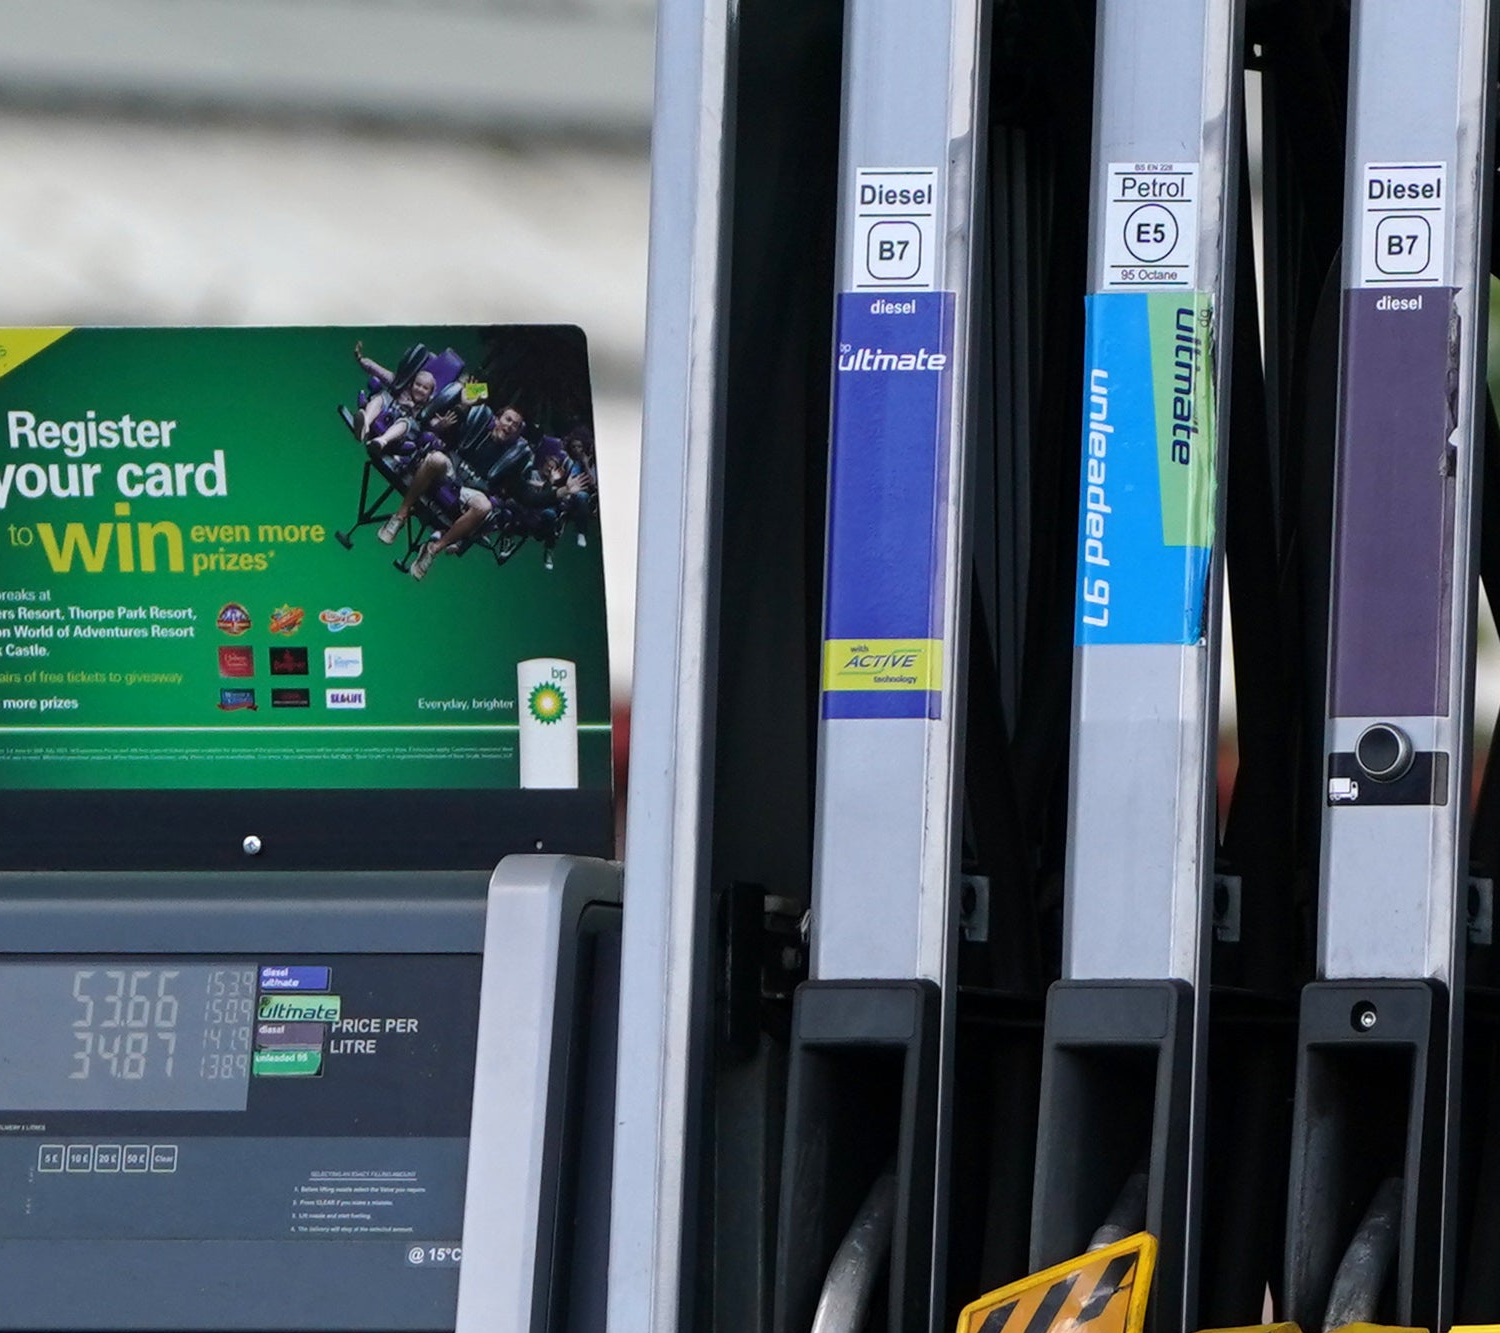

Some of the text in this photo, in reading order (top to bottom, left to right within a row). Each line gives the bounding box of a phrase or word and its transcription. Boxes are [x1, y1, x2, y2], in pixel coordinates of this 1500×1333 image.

[860, 184, 932, 205] Diesel
[1121, 176, 1185, 199] Petrol
[1367, 179, 1441, 200] Diesel
[1136, 223, 1166, 244] E5
[878, 240, 909, 261] B7
[1387, 235, 1419, 256] B7
[1121, 270, 1177, 281] 95 Octane
[870, 300, 916, 315] diesel
[1376, 294, 1422, 311] diesel
[839, 348, 946, 371] ultimate
[1172, 308, 1194, 466] ultimate
[8, 410, 177, 457] Register
[115, 450, 227, 497] card
[1083, 369, 1114, 627] unleaded 97
[8, 502, 327, 573] to win even more
[39, 590, 51, 601] at
[18, 607, 65, 621] Resort,
[68, 606, 114, 621] Thorpe
[118, 607, 146, 619] Park
[150, 606, 197, 620] Resort,
[14, 625, 53, 638] World
[57, 625, 70, 637] of
[73, 625, 148, 638] Adventures
[151, 625, 194, 637] Resort
[851, 645, 868, 653] with
[844, 655, 917, 668] ACTIVE
[551, 667, 567, 681] bp
[3, 699, 37, 709] more
[40, 696, 78, 711] prizes
[418, 698, 514, 711] Everyday, brighter
[260, 1004, 337, 1019] ultimate
[330, 1018, 419, 1034] PRICE PER
[330, 1040, 377, 1054] LITRE
[408, 1247, 424, 1264] @
